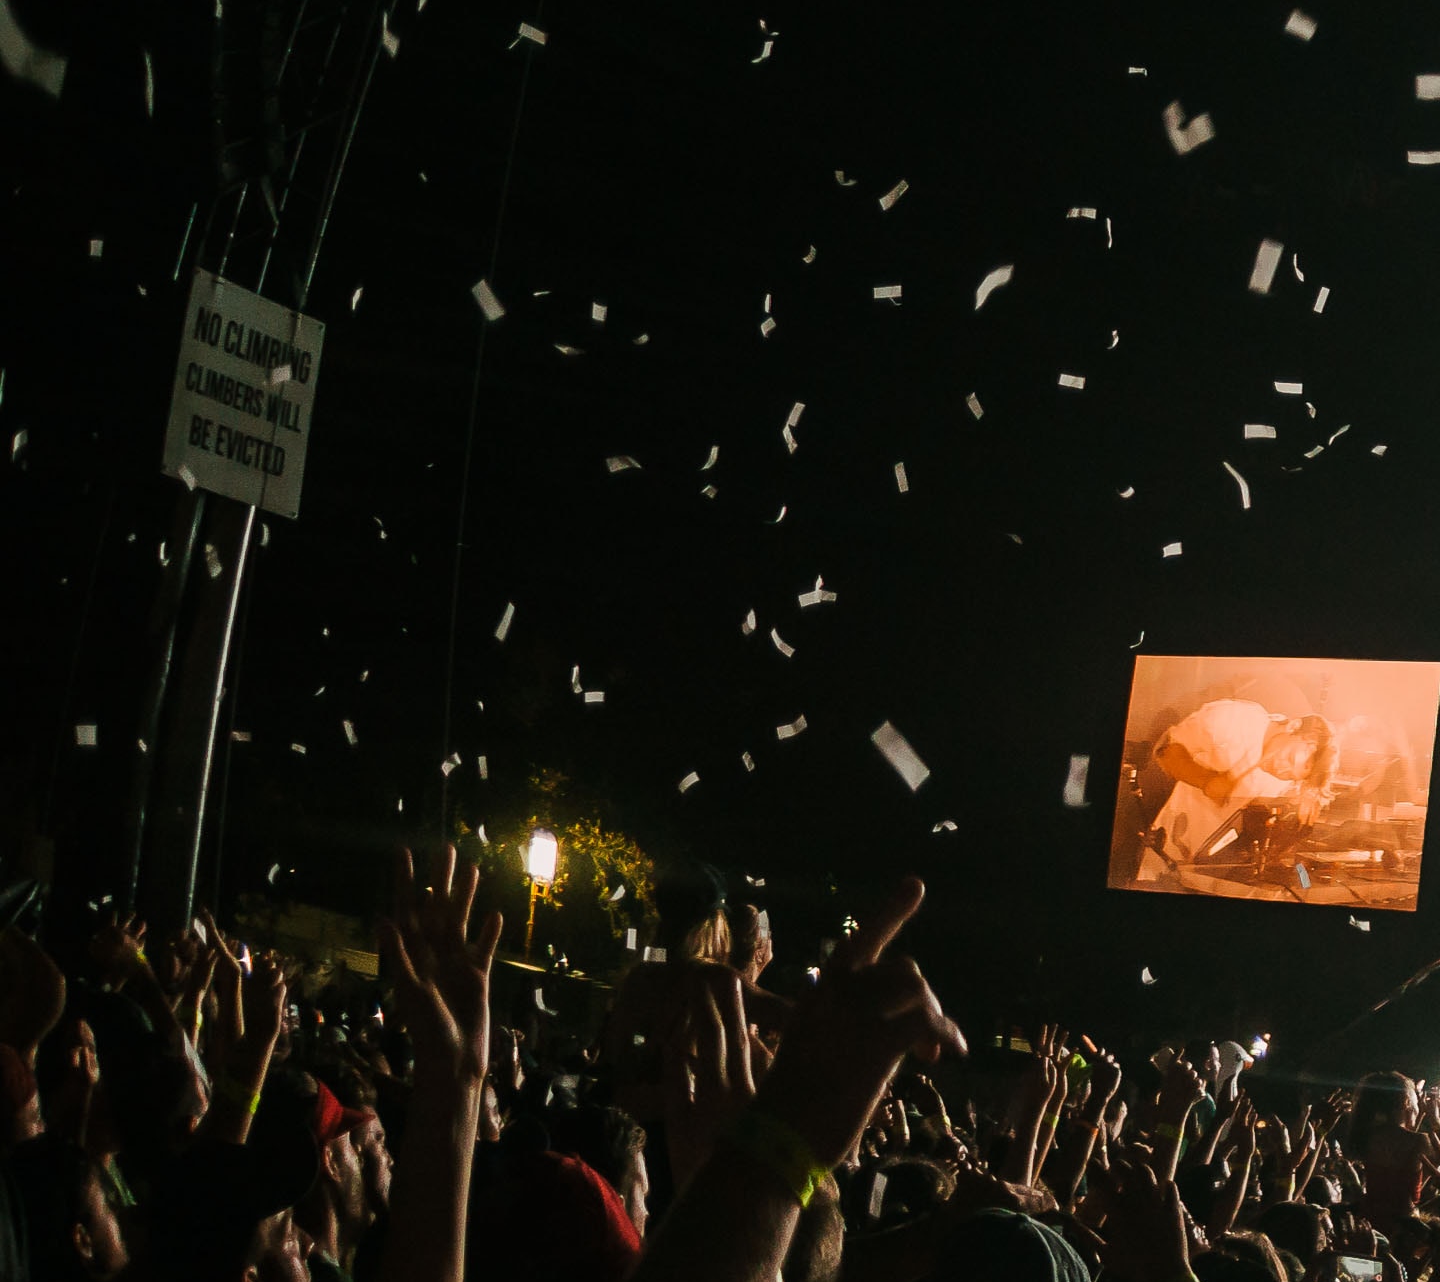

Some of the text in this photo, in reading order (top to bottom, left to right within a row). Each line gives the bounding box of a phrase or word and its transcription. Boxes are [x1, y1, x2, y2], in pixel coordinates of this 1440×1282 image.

[194, 306, 221, 347] NO
[185, 362, 301, 432] CLIMBERS WILL
[189, 414, 286, 477] BE EVICTED
